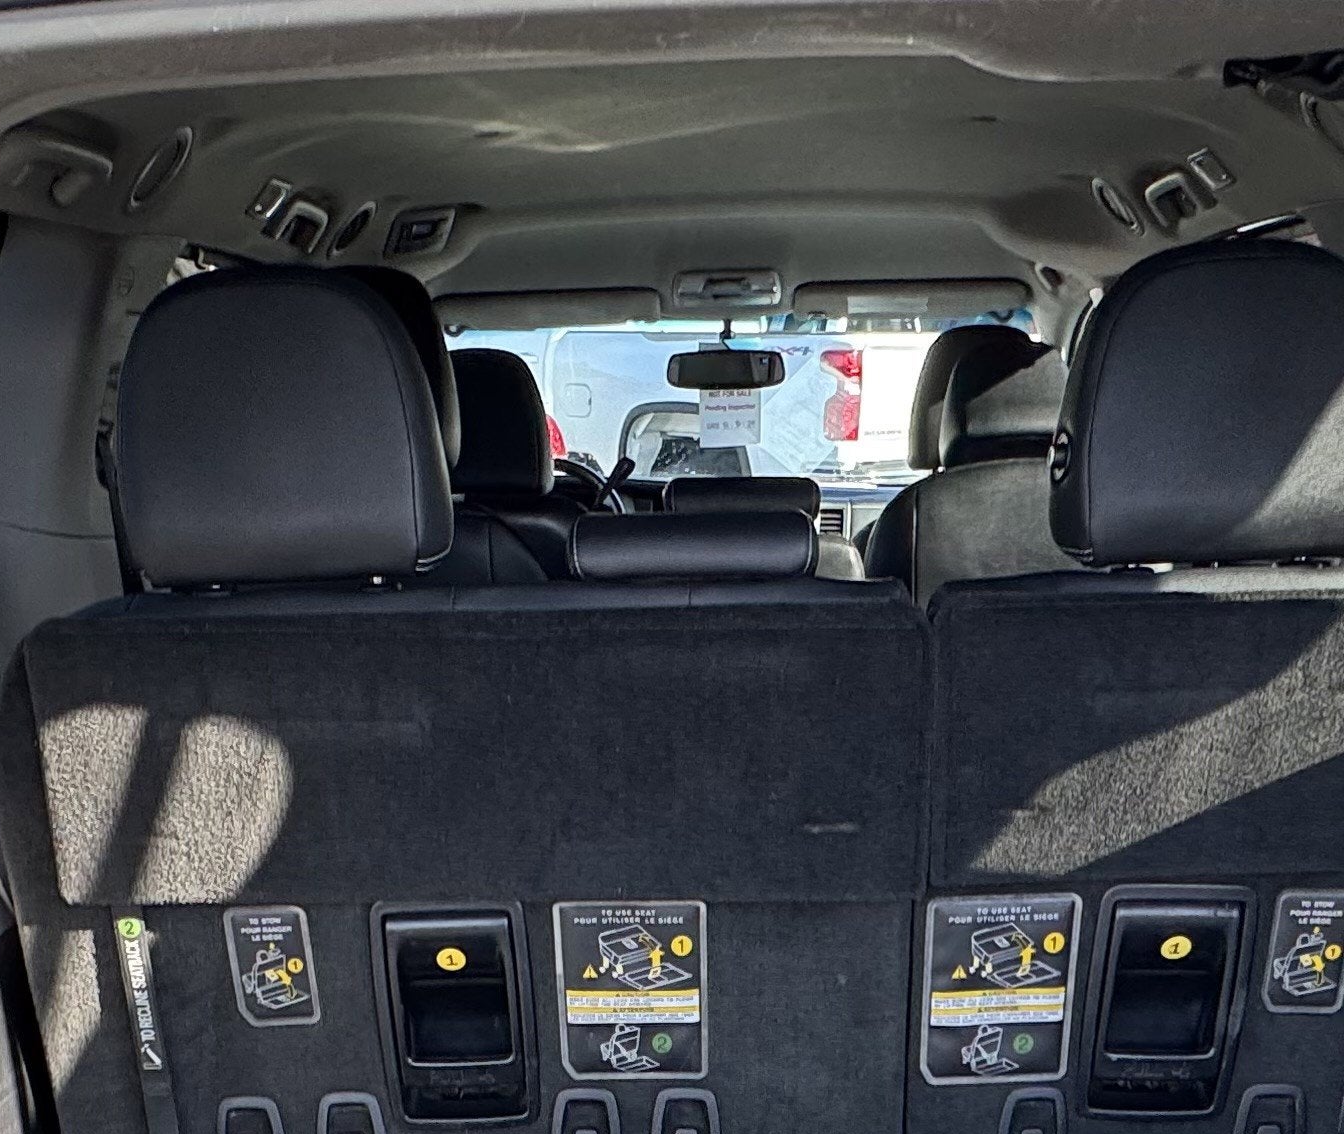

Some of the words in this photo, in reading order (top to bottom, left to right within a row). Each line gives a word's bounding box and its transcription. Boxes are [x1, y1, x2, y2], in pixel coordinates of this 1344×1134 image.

[977, 907, 989, 915] TO
[991, 907, 1008, 915] USE
[1011, 905, 1032, 914] SEAT
[948, 916, 972, 924] POUR
[124, 921, 135, 936] 2
[124, 940, 147, 989] SEATBACK
[133, 990, 154, 1029] RECLINE
[140, 1029, 155, 1042] TO
